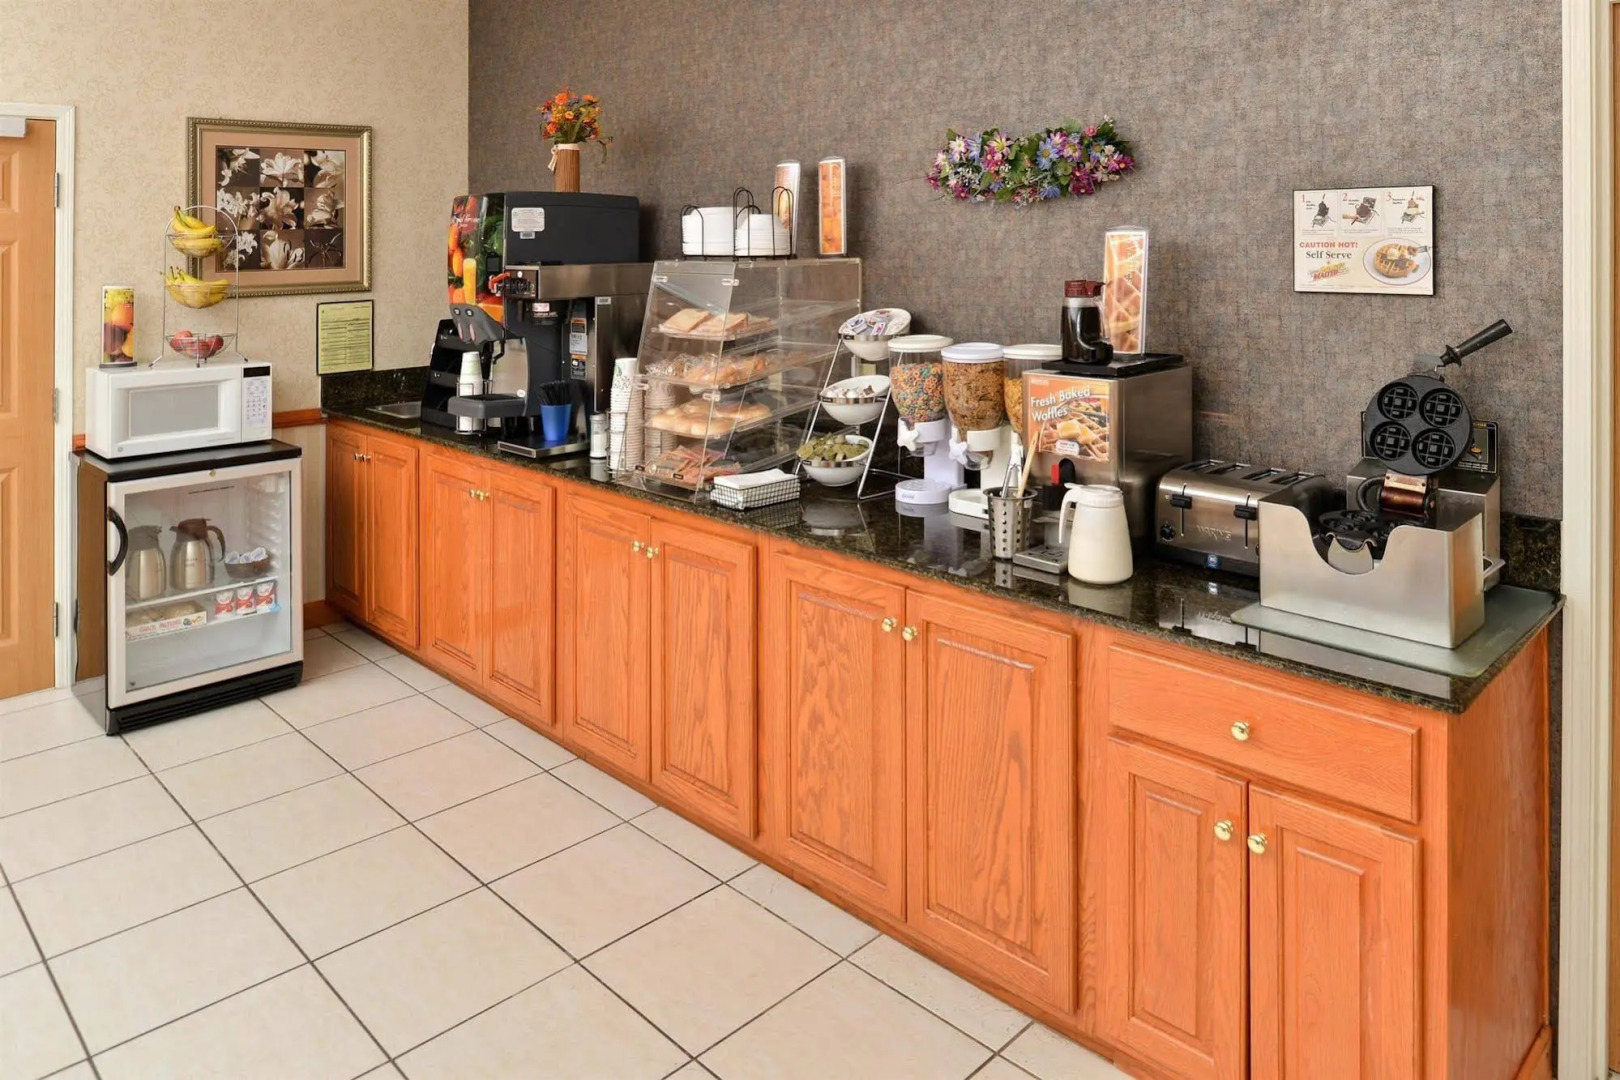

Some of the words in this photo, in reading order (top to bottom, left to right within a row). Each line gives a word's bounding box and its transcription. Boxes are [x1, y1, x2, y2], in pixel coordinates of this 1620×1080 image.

[1342, 192, 1348, 202] 2
[1299, 241, 1336, 249] CAUTION
[1338, 241, 1358, 249] HOT!
[1305, 250, 1324, 259] Self
[1325, 250, 1352, 259] Serve
[1030, 393, 1056, 407] Fresh
[1058, 385, 1091, 402] Baked
[1031, 406, 1068, 422] Waffles
